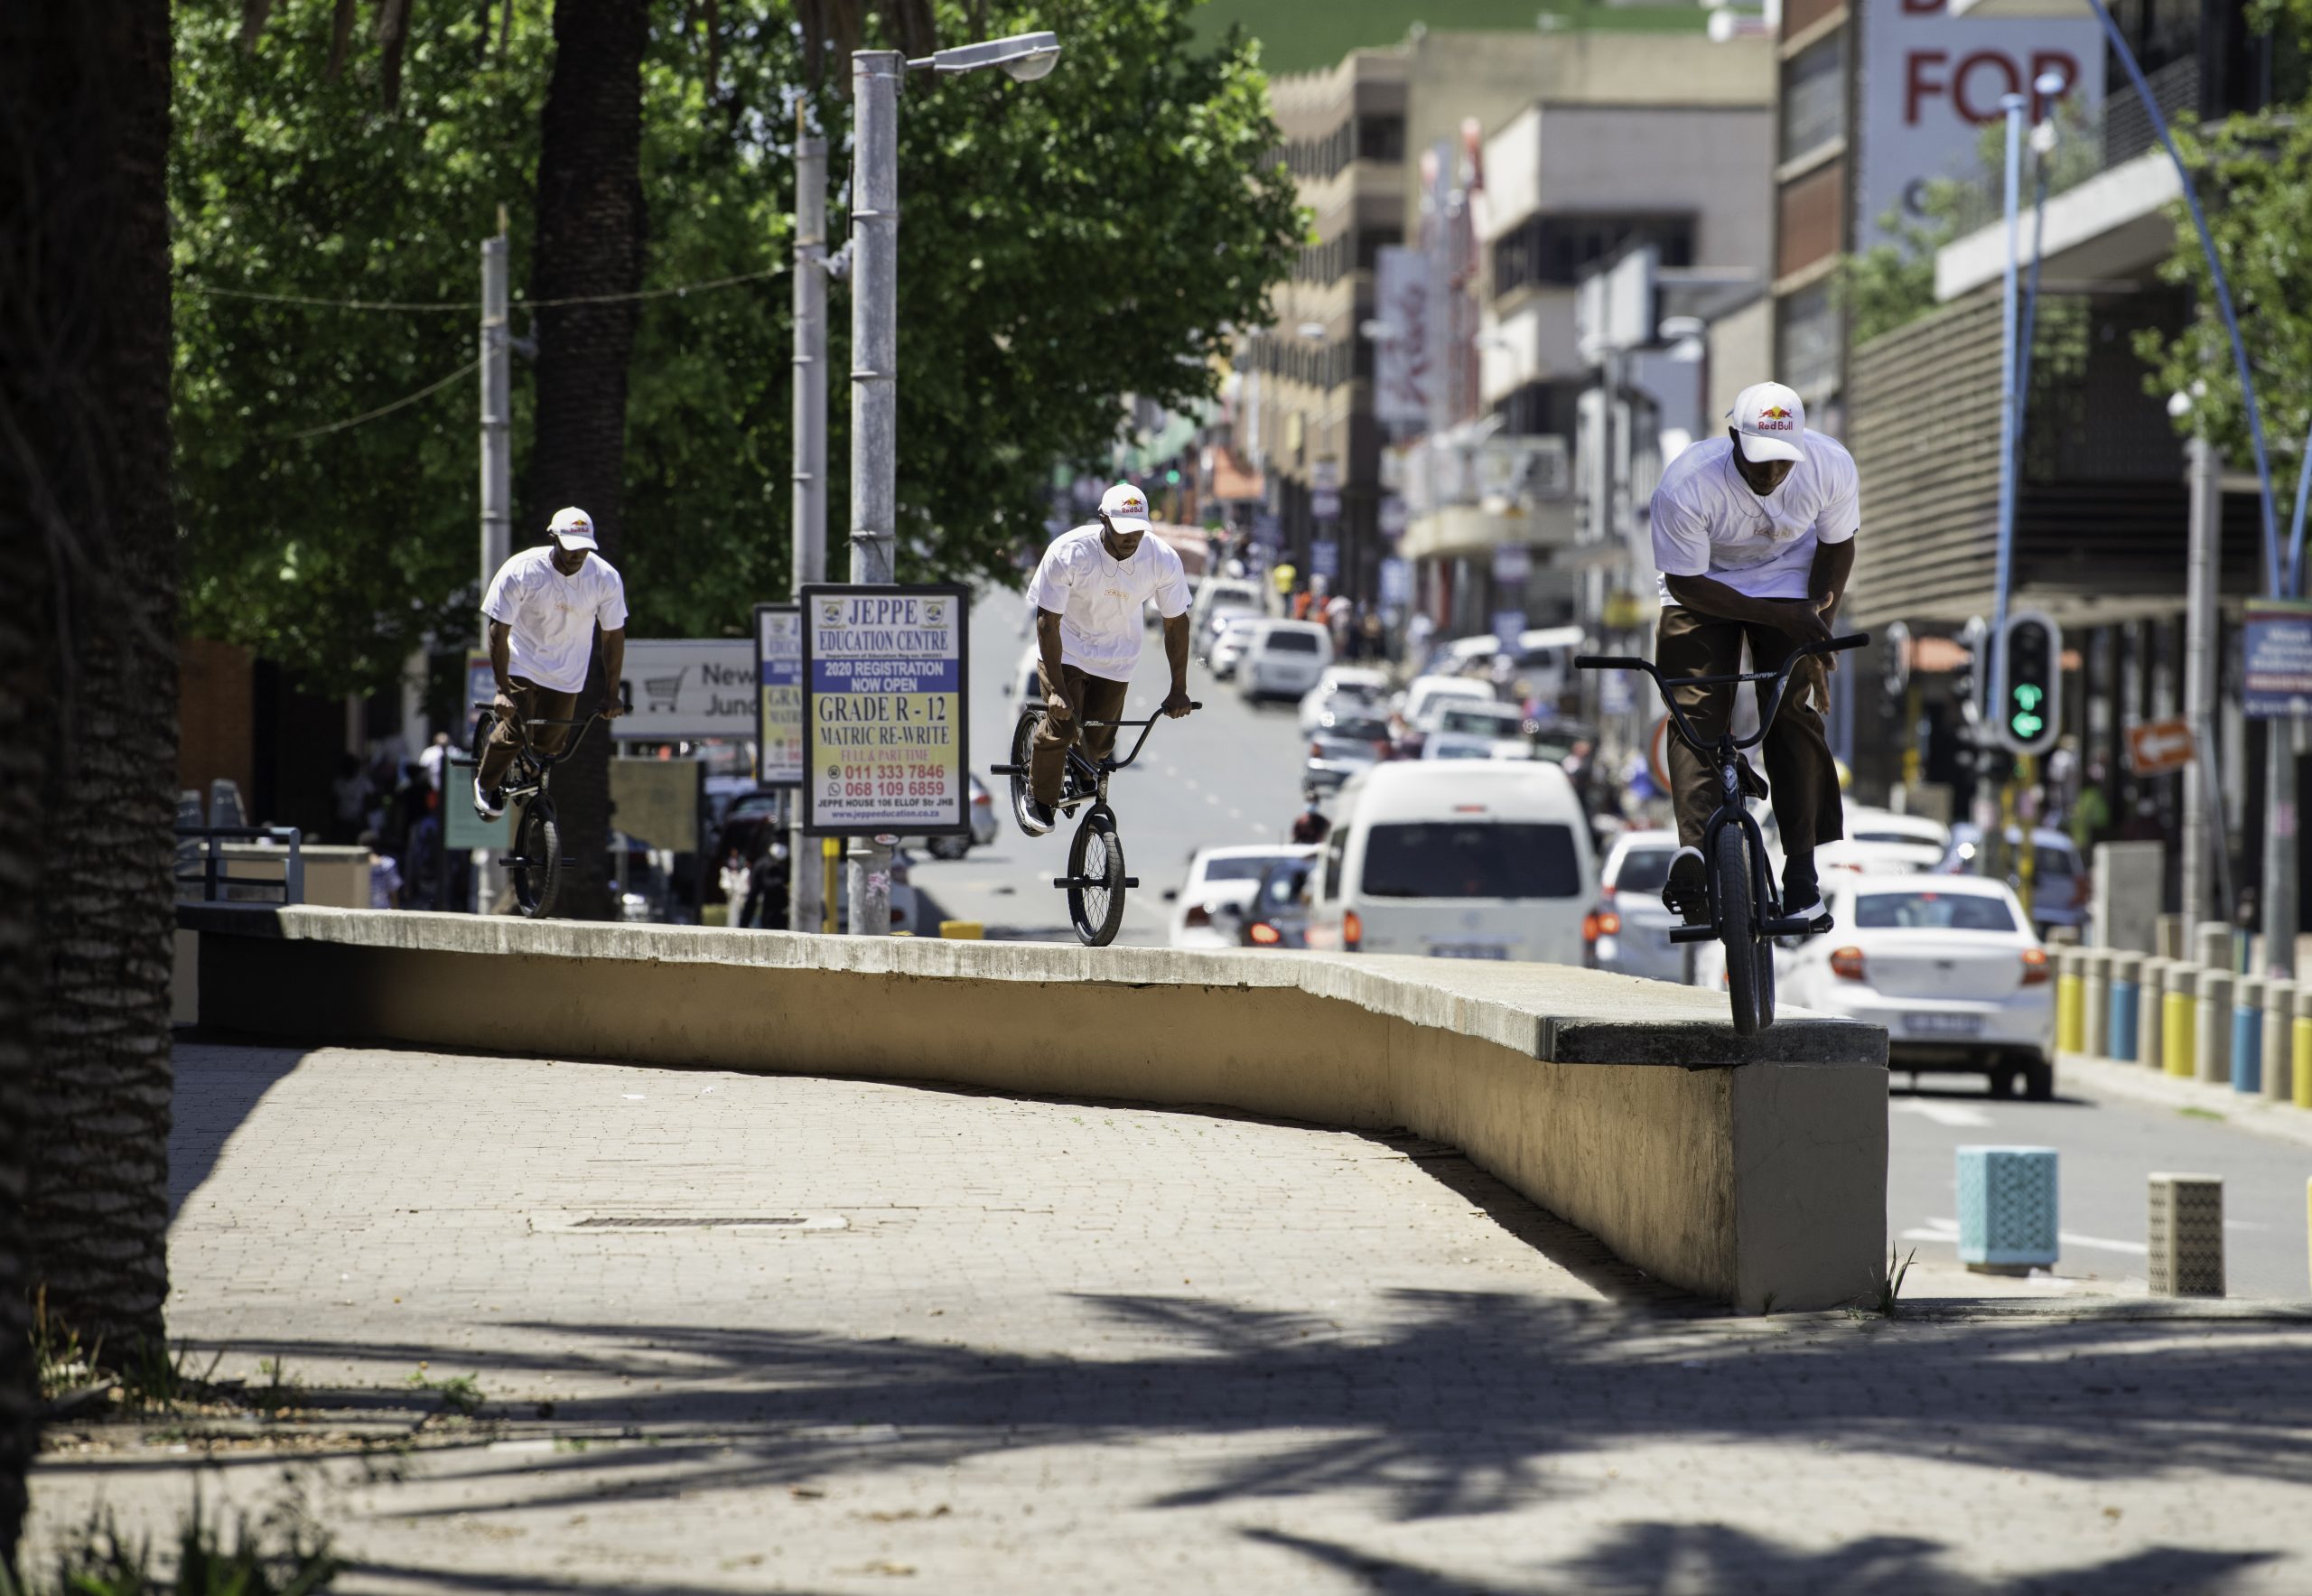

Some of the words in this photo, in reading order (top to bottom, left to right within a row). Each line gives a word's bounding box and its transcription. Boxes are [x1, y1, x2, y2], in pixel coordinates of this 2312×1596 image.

[1757, 421, 1776, 431] Red
[1777, 421, 1794, 431] Bull
[849, 599, 918, 625] JEPPE
[819, 630, 893, 651] EDUCATION
[897, 630, 948, 651] CENTRE
[702, 662, 756, 685] New
[825, 661, 852, 677] 2020
[854, 661, 945, 677] REGISTRATION
[852, 677, 881, 692] NOW
[883, 677, 918, 692] OPEN
[819, 695, 890, 722] GRADE
[896, 695, 909, 722] R
[928, 695, 946, 721] 12
[820, 725, 875, 745] MATRIC
[879, 725, 950, 745] RE-WRITE
[841, 750, 865, 761] FULL
[867, 750, 875, 761] &
[878, 749, 902, 761] PART
[904, 749, 929, 761] TIME
[844, 765, 872, 779] 011
[877, 765, 904, 779] 333
[909, 764, 945, 779] 7846
[845, 782, 872, 796] 068
[878, 782, 904, 796] 109
[909, 781, 945, 796] 6859
[817, 799, 844, 807] JEPPE
[894, 798, 919, 807] ELLOF
[922, 798, 934, 807] Str
[937, 798, 954, 807] JHB
[832, 810, 939, 820] www.jeppeeducation.co.za
